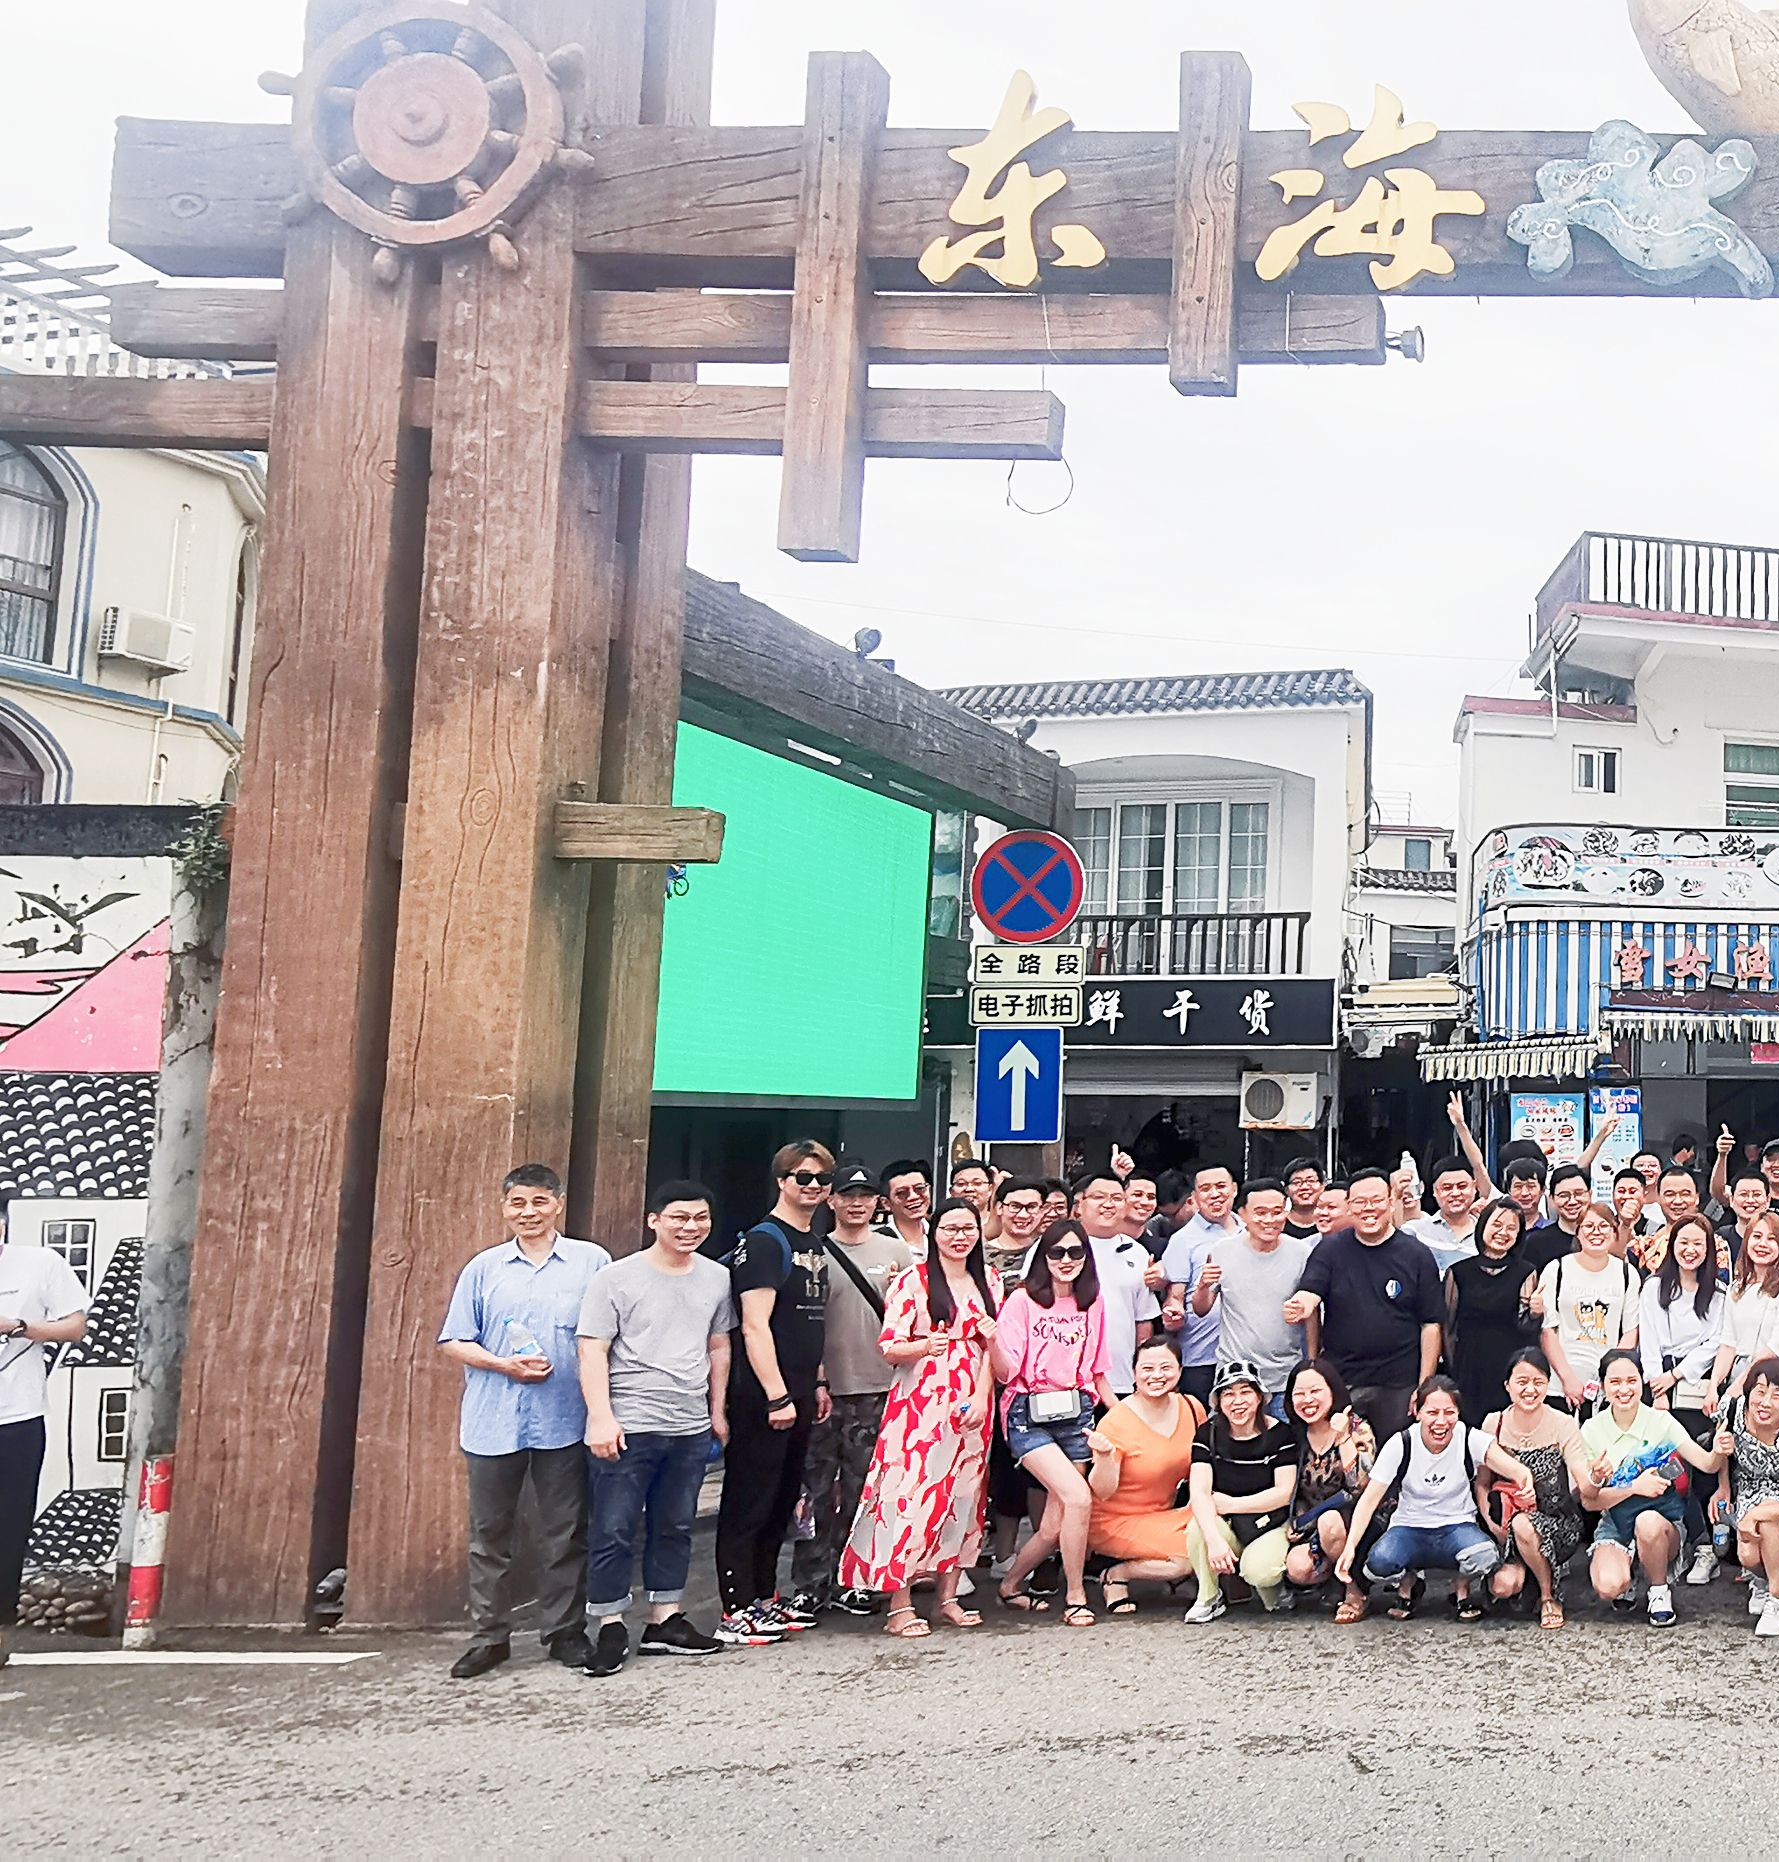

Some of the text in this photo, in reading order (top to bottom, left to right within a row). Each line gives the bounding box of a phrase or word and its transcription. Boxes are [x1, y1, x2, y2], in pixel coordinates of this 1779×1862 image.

[979, 953, 1080, 975] 全路段
[977, 993, 1073, 1018] 电子抓拍
[1084, 988, 1275, 1036] 鲜干货
